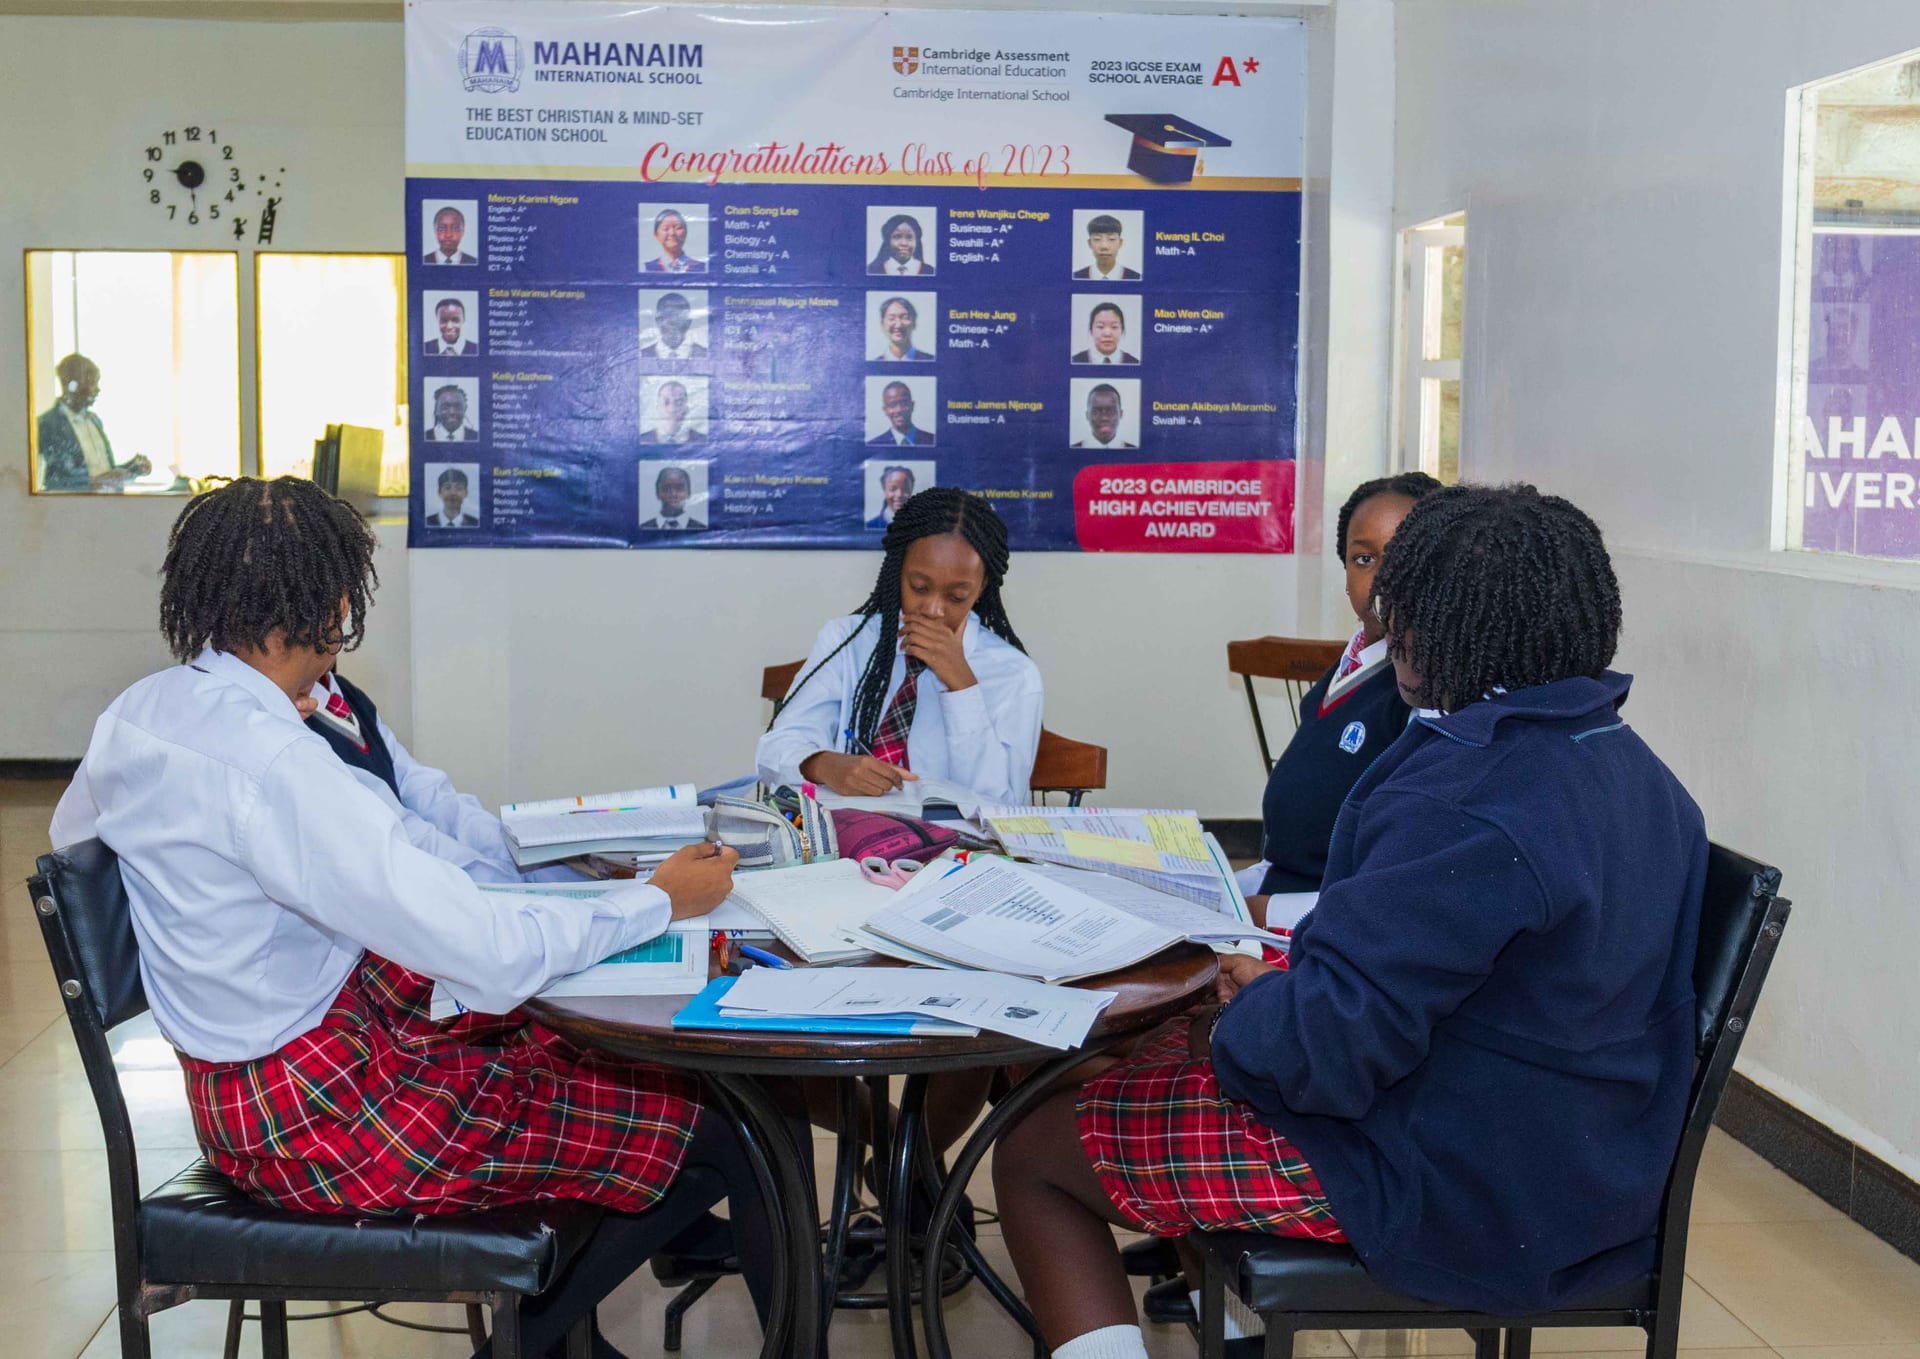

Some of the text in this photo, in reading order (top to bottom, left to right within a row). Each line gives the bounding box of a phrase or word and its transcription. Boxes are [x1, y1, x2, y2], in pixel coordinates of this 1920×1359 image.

[533, 41, 703, 68] MAHANAIM
[922, 48, 1070, 63] Cambridge Assessment
[921, 63, 1066, 78] International Education
[1091, 60, 1202, 73] 2023 IGCSE EXAM
[534, 69, 703, 85] INTERNATIONAL SCHOOL
[1088, 73, 1204, 85] SCHOOL AVERAGE
[893, 87, 1070, 102] Cambridge International School
[466, 108, 704, 126] THE BEST CHRISTIAN & MIND-SET
[163, 130, 176, 145] 11
[184, 126, 201, 141] 12
[208, 129, 216, 144] 1
[466, 126, 608, 143] EDUCATION SCHOOL
[145, 147, 162, 161] 10
[222, 145, 233, 160] 2
[640, 141, 1071, 189] Congratulations Class of 2023
[143, 168, 154, 183] 9
[230, 167, 240, 182] 3
[150, 189, 161, 204] 8
[224, 189, 234, 202] 4
[167, 204, 176, 220] 7
[210, 204, 220, 219] 5
[724, 205, 751, 216] Chan
[949, 209, 976, 219] Irene
[1017, 210, 1050, 221] Chege
[188, 211, 199, 225] 6
[724, 220, 750, 230] Math
[949, 223, 993, 234] Business
[724, 235, 761, 247] Biology
[767, 235, 777, 244] A
[949, 238, 984, 248] Swahili
[1155, 231, 1190, 243] Kwang
[1202, 232, 1225, 242] Choi
[724, 249, 774, 262] Chemistry
[781, 250, 790, 259] A
[949, 252, 984, 264] English
[991, 253, 1000, 262] A
[1155, 246, 1180, 256] Math
[1187, 246, 1196, 256] A
[768, 264, 777, 274] A
[1154, 308, 1225, 320] Mao Wen Qian
[949, 324, 988, 334] Chinese
[1154, 323, 1192, 333] Chinese
[949, 339, 975, 349] Math
[980, 339, 990, 348] A
[1152, 401, 1190, 411] Duncan
[1191, 401, 1230, 414] Akibaya
[947, 414, 990, 424] Business
[997, 414, 1005, 424] A
[1152, 415, 1186, 426] Swahili
[1192, 416, 1201, 425] A
[1100, 478, 1262, 496] 2023 CAMBRIDGE
[1805, 471, 1920, 509] IVER
[1089, 500, 1272, 517] HIGH ACHIEVEMENT
[1144, 522, 1216, 538] AWARD
